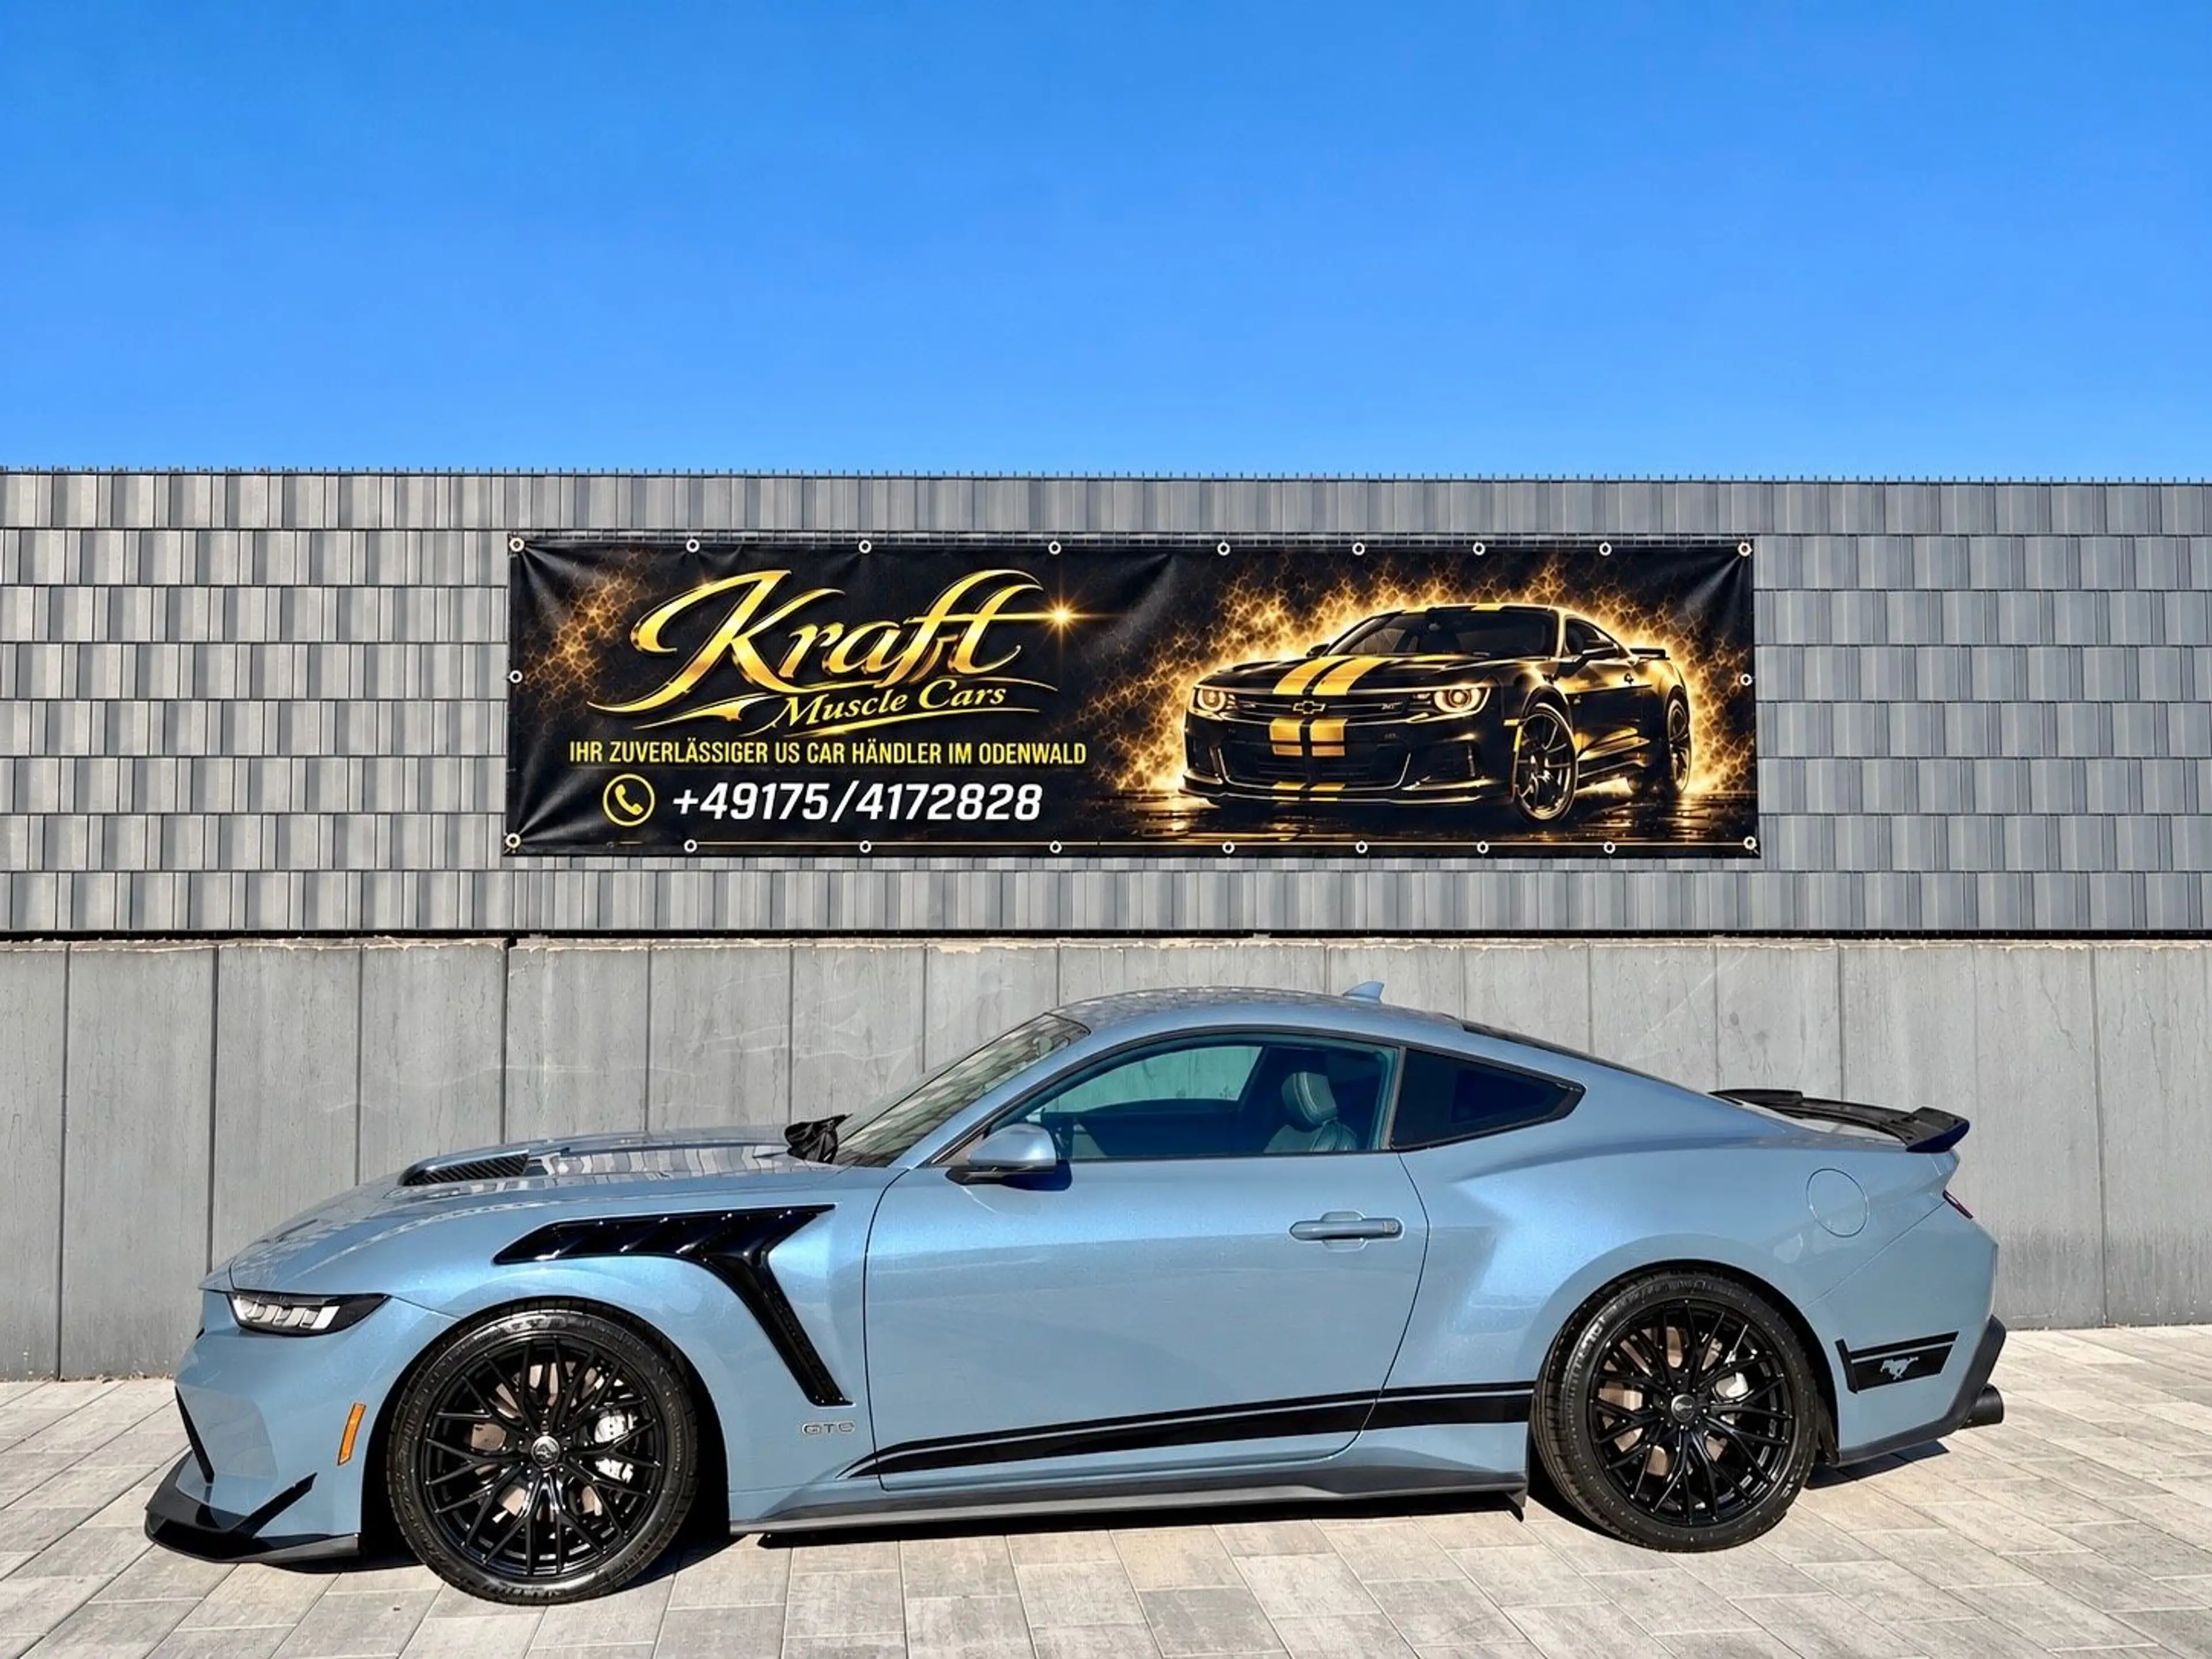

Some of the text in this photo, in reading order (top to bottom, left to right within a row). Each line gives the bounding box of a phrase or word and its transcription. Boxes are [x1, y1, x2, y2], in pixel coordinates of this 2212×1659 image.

[586, 569, 1045, 713] Kraft
[771, 679, 1006, 726] Muscle Cars
[569, 737, 1086, 765] IHR ZUVERLÄSSIGER US CAR HÄNDLER IM ODENWALD
[672, 780, 1043, 823] +49175/4172828
